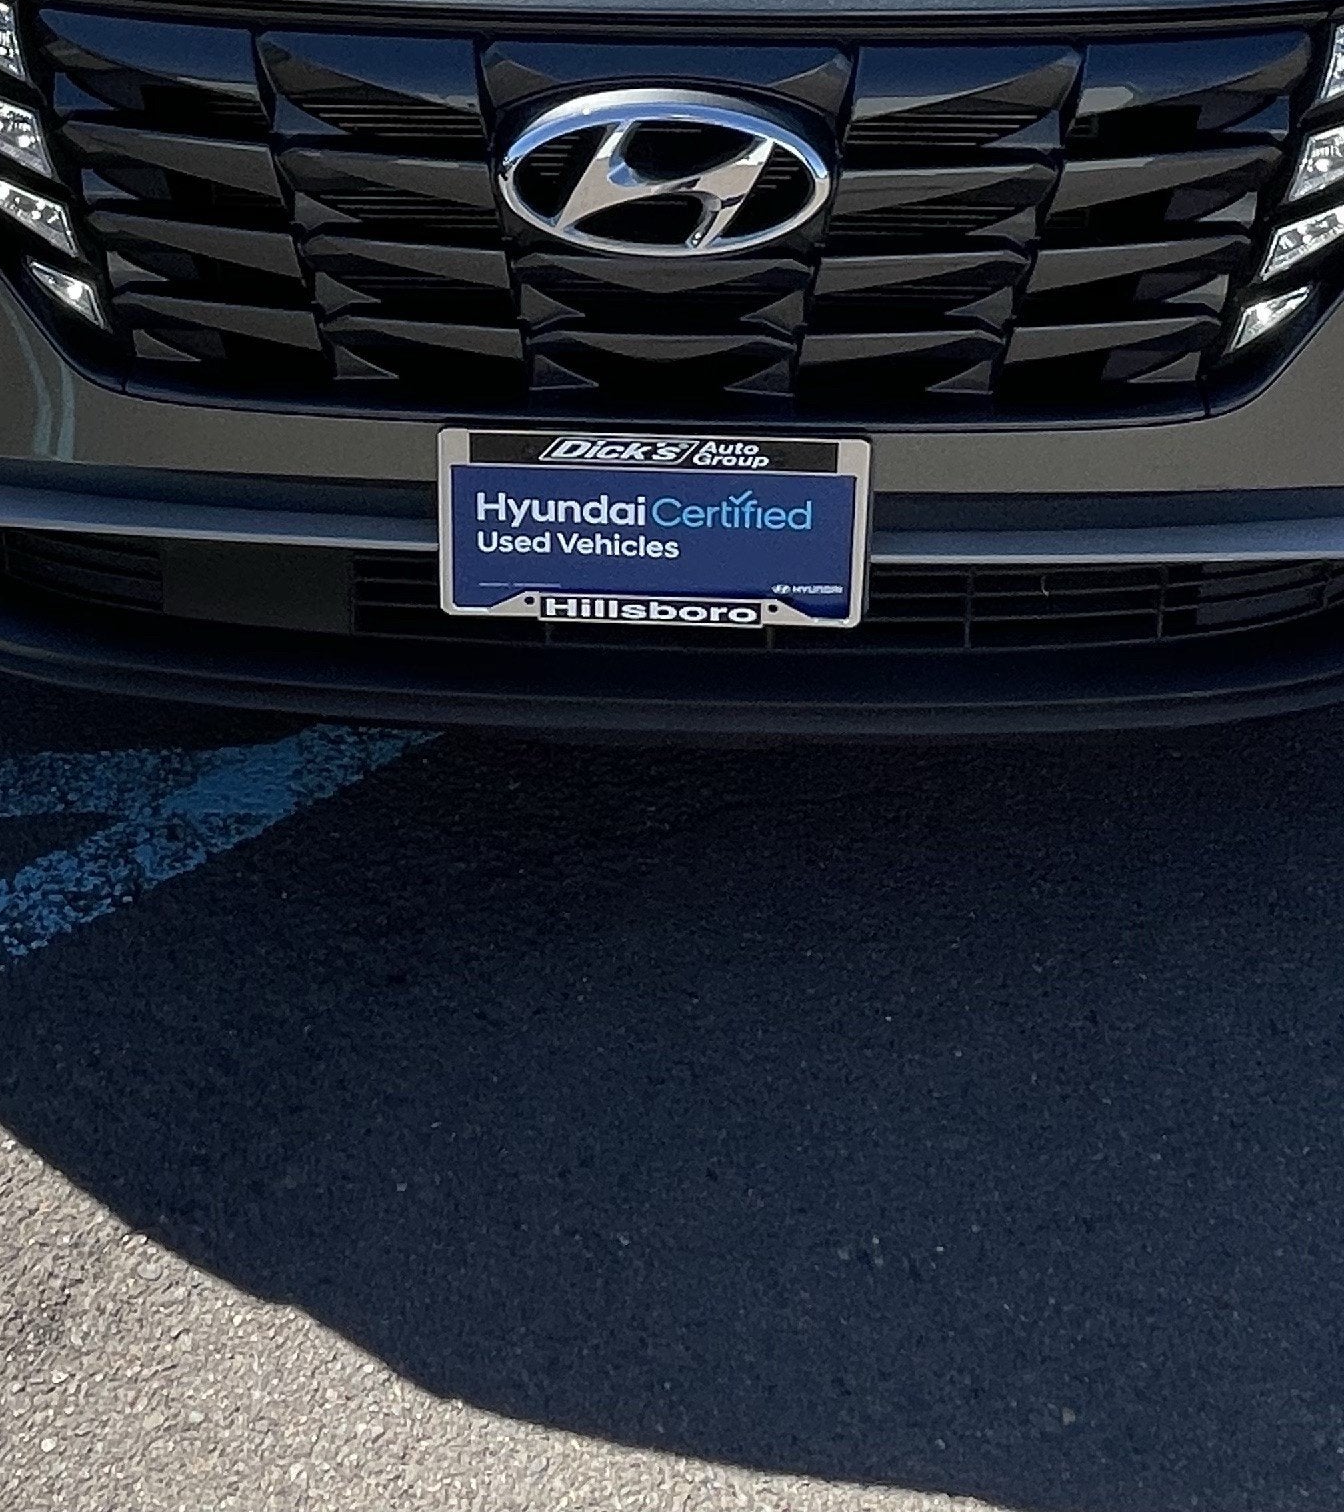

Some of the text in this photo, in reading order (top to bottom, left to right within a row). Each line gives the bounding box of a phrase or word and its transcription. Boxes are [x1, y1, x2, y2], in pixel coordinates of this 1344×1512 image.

[550, 439, 760, 461] Dick's Auto
[692, 453, 770, 469] Group
[475, 491, 813, 530] Hyundai Certified
[476, 531, 680, 559] Used Vehicles
[545, 597, 758, 624] Hillsboro
